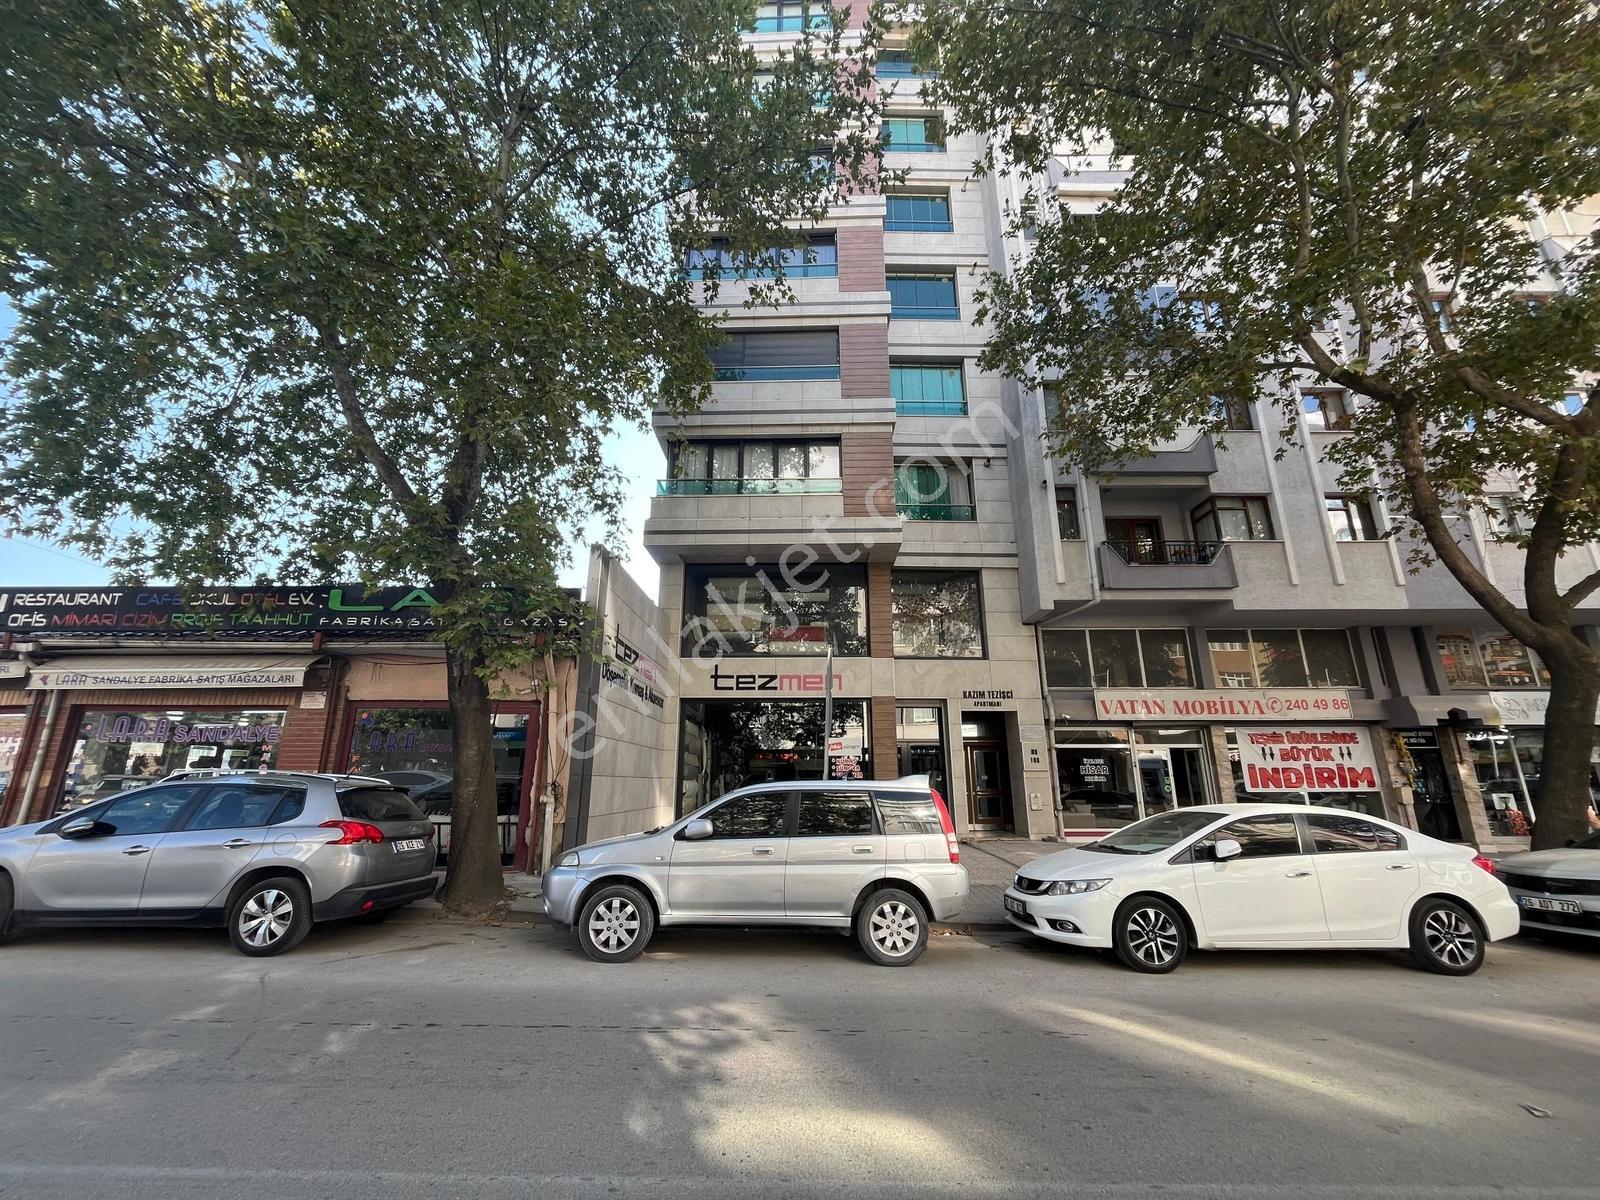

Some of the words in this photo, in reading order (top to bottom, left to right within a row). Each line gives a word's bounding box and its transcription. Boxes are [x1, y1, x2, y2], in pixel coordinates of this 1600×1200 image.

[13, 592, 123, 607] RESTAURANT
[136, 593, 184, 606] CAFE
[8, 611, 47, 627] OFİS
[51, 610, 118, 627] MİMARİ
[171, 613, 224, 627] PROJE
[229, 610, 313, 627] TAAHHÜT
[319, 615, 403, 626] FABRİKA
[55, 674, 87, 686] LARA
[92, 675, 146, 685] SANDALYE
[149, 675, 193, 684] FABRİKA
[710, 664, 843, 691] tezmen
[962, 690, 985, 699] KAZIM
[1100, 699, 1166, 715] VATAN
[1173, 696, 1266, 715] MOBİLYA
[1286, 699, 1308, 710] 240
[1313, 699, 1329, 710] 49
[1333, 698, 1349, 710] 86
[96, 716, 171, 742] LARA
[173, 725, 281, 743] SANDALYE
[1280, 747, 1335, 761] BÜYÜK
[1080, 765, 1109, 775] HİSAR
[1248, 764, 1376, 788] İNDİRİM
